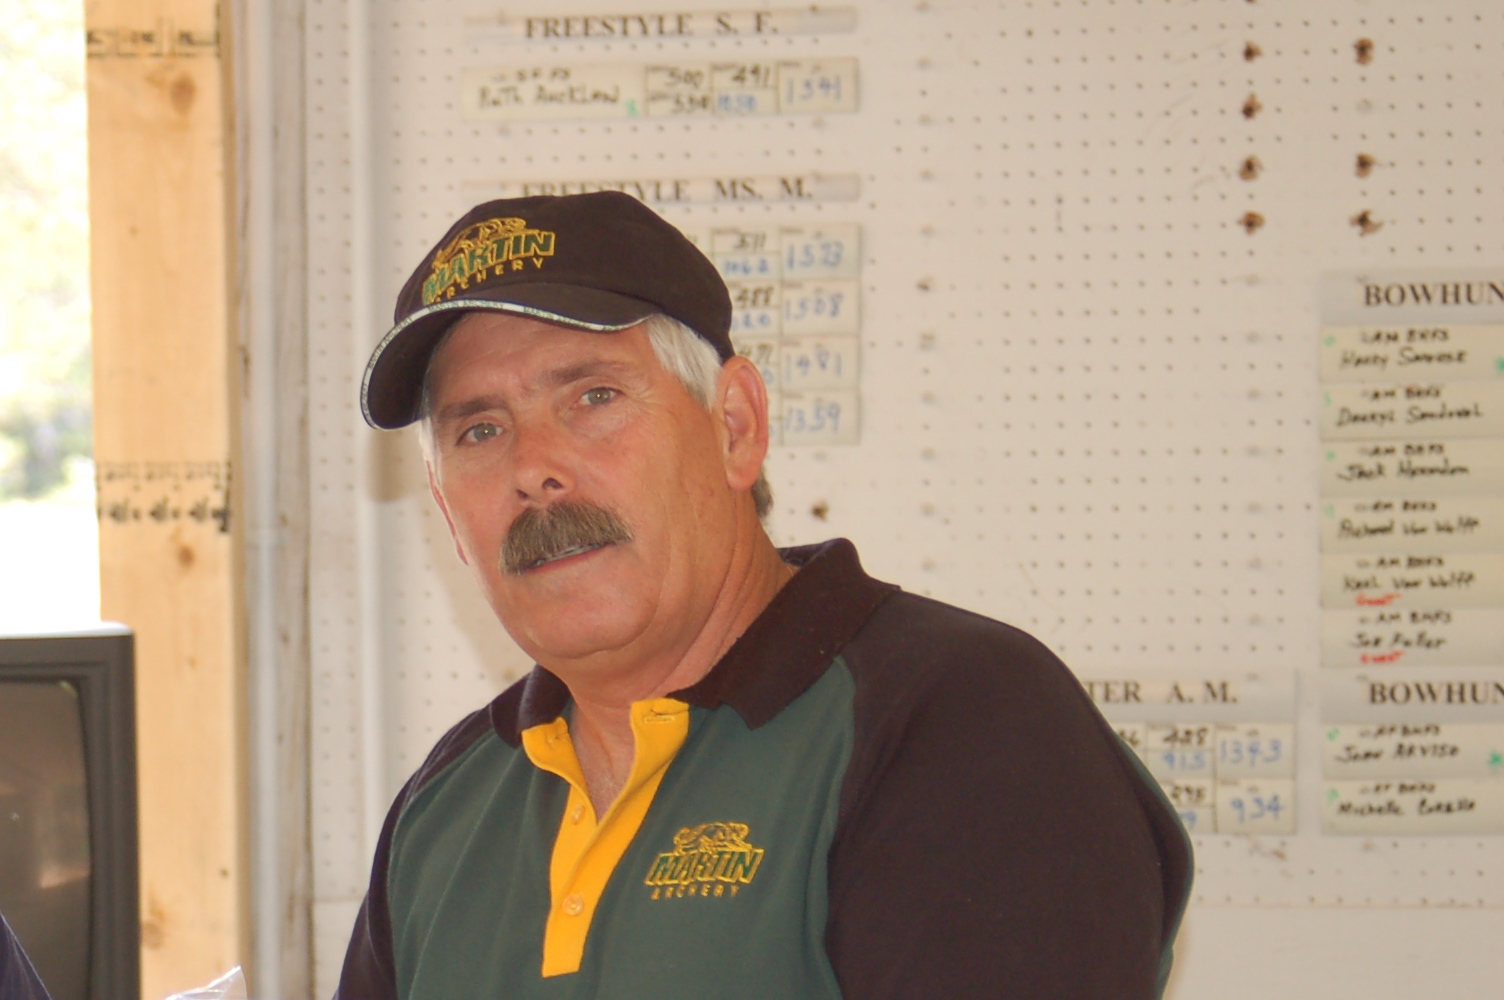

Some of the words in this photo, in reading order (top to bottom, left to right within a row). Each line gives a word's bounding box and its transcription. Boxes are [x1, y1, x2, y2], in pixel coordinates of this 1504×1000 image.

[525, 15, 694, 40] FREESTYLE
[715, 178, 763, 199] MS.
[422, 229, 556, 306] MARTIN
[644, 847, 765, 886] MARTIN
